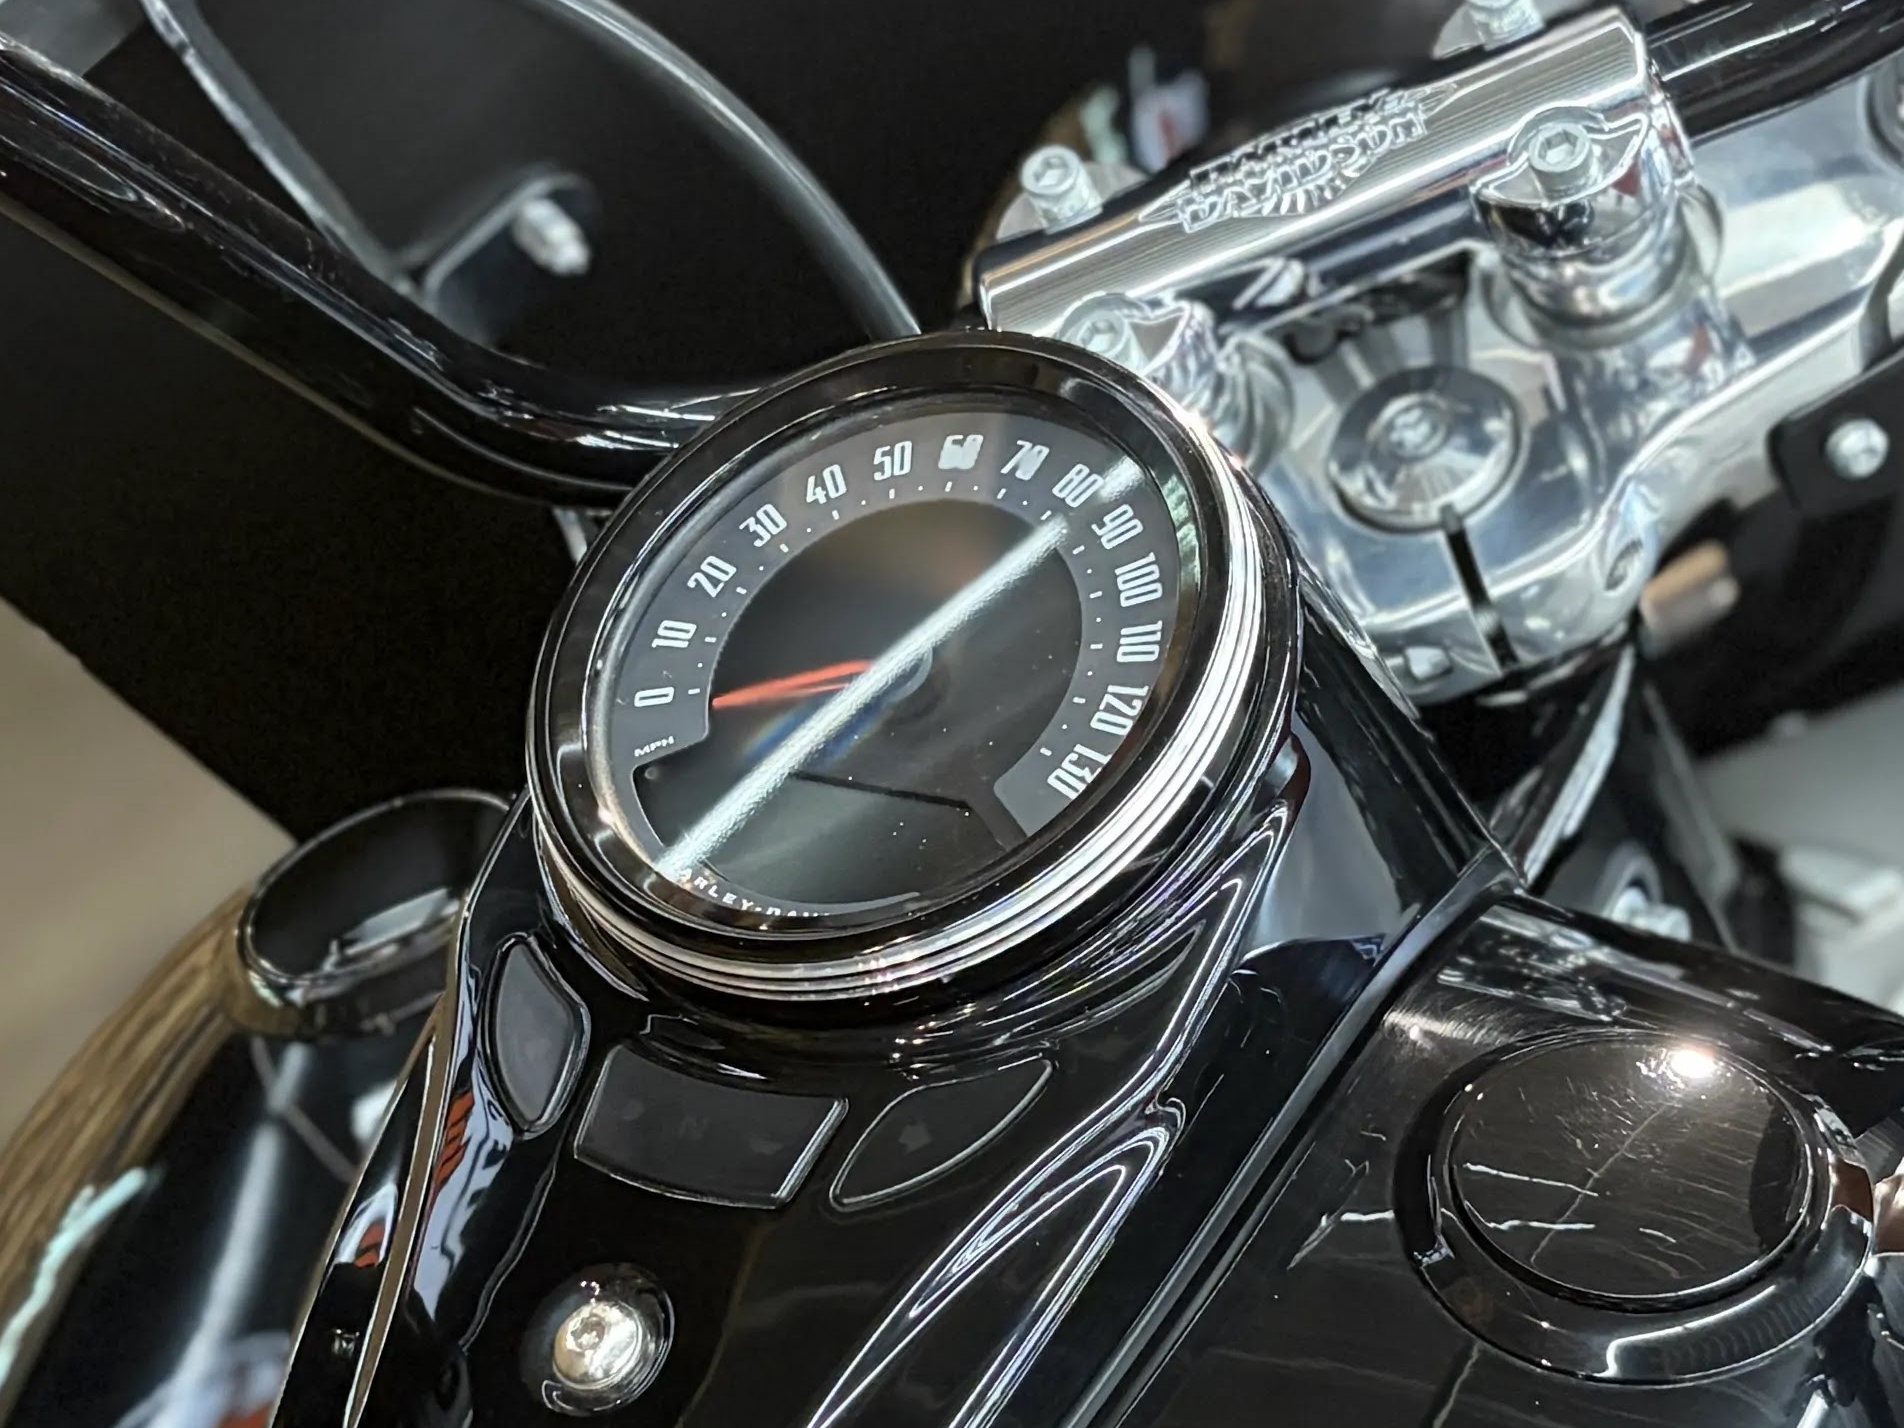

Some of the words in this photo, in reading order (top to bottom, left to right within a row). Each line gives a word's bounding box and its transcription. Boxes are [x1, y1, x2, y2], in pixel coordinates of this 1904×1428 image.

[872, 440, 913, 481] 50
[937, 434, 984, 471] 60
[1000, 439, 1050, 482] 70
[805, 463, 848, 505] 40
[1051, 463, 1105, 509] 80
[738, 503, 788, 548] 30
[1090, 503, 1144, 550] 90
[686, 555, 737, 598] 20
[1114, 551, 1163, 608] 100
[651, 619, 698, 649] 10
[1116, 619, 1163, 663] 110
[633, 686, 675, 708] 0
[1089, 684, 1150, 736] 120
[633, 735, 675, 758] MPH
[1046, 743, 1114, 801] 130
